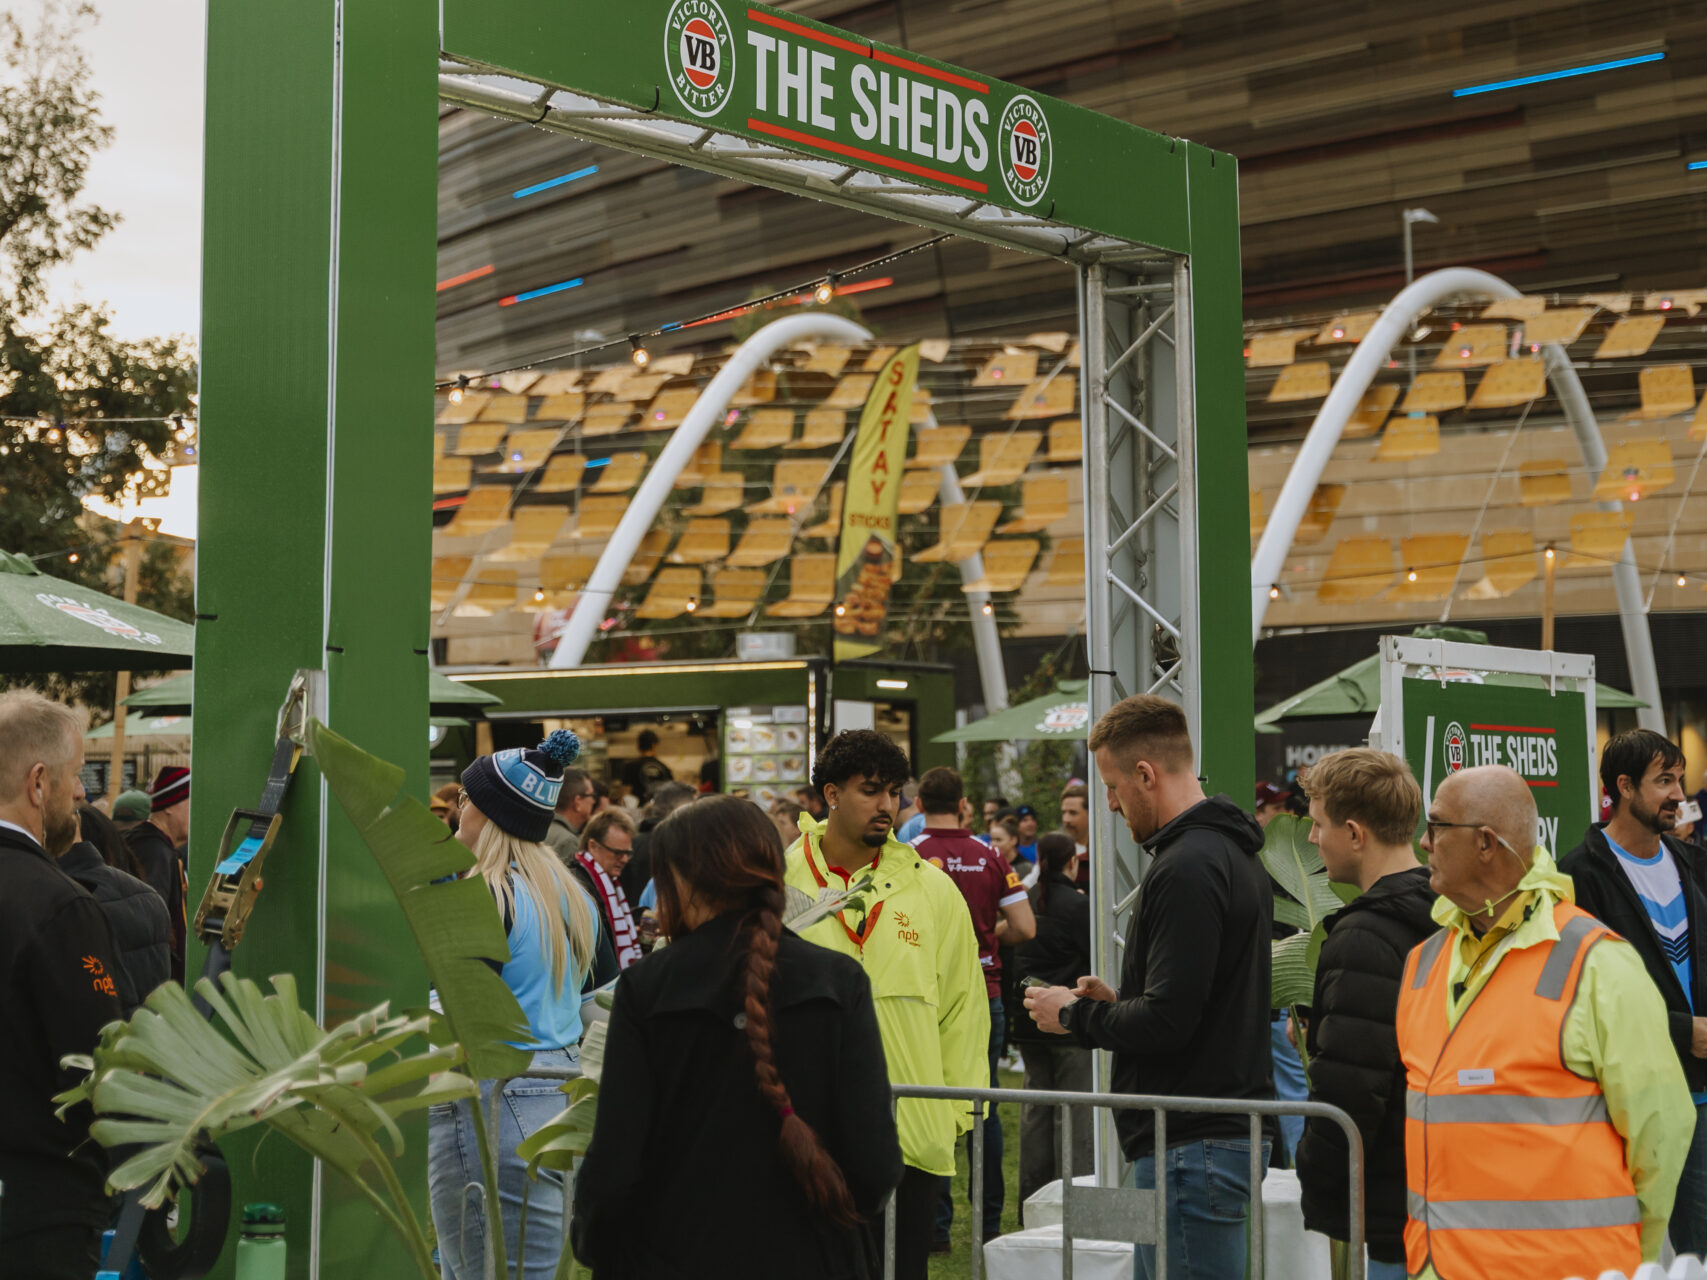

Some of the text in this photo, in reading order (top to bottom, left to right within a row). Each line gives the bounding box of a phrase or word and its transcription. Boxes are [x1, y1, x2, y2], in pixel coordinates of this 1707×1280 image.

[671, 0, 728, 47] VICTORIA
[684, 34, 716, 72] VB
[676, 72, 725, 108] BITTER
[747, 30, 989, 173] THE SHEDS
[1004, 103, 1047, 144] VICTORIA
[1013, 134, 1038, 166] VB
[1007, 168, 1044, 198] BITTER
[871, 360, 905, 507] SATAY
[848, 512, 890, 530] STICKS
[1450, 746, 1461, 762] VB
[1470, 734, 1558, 777] THE SHEDS
[1536, 816, 1559, 862] RY
[898, 929, 919, 942] npb
